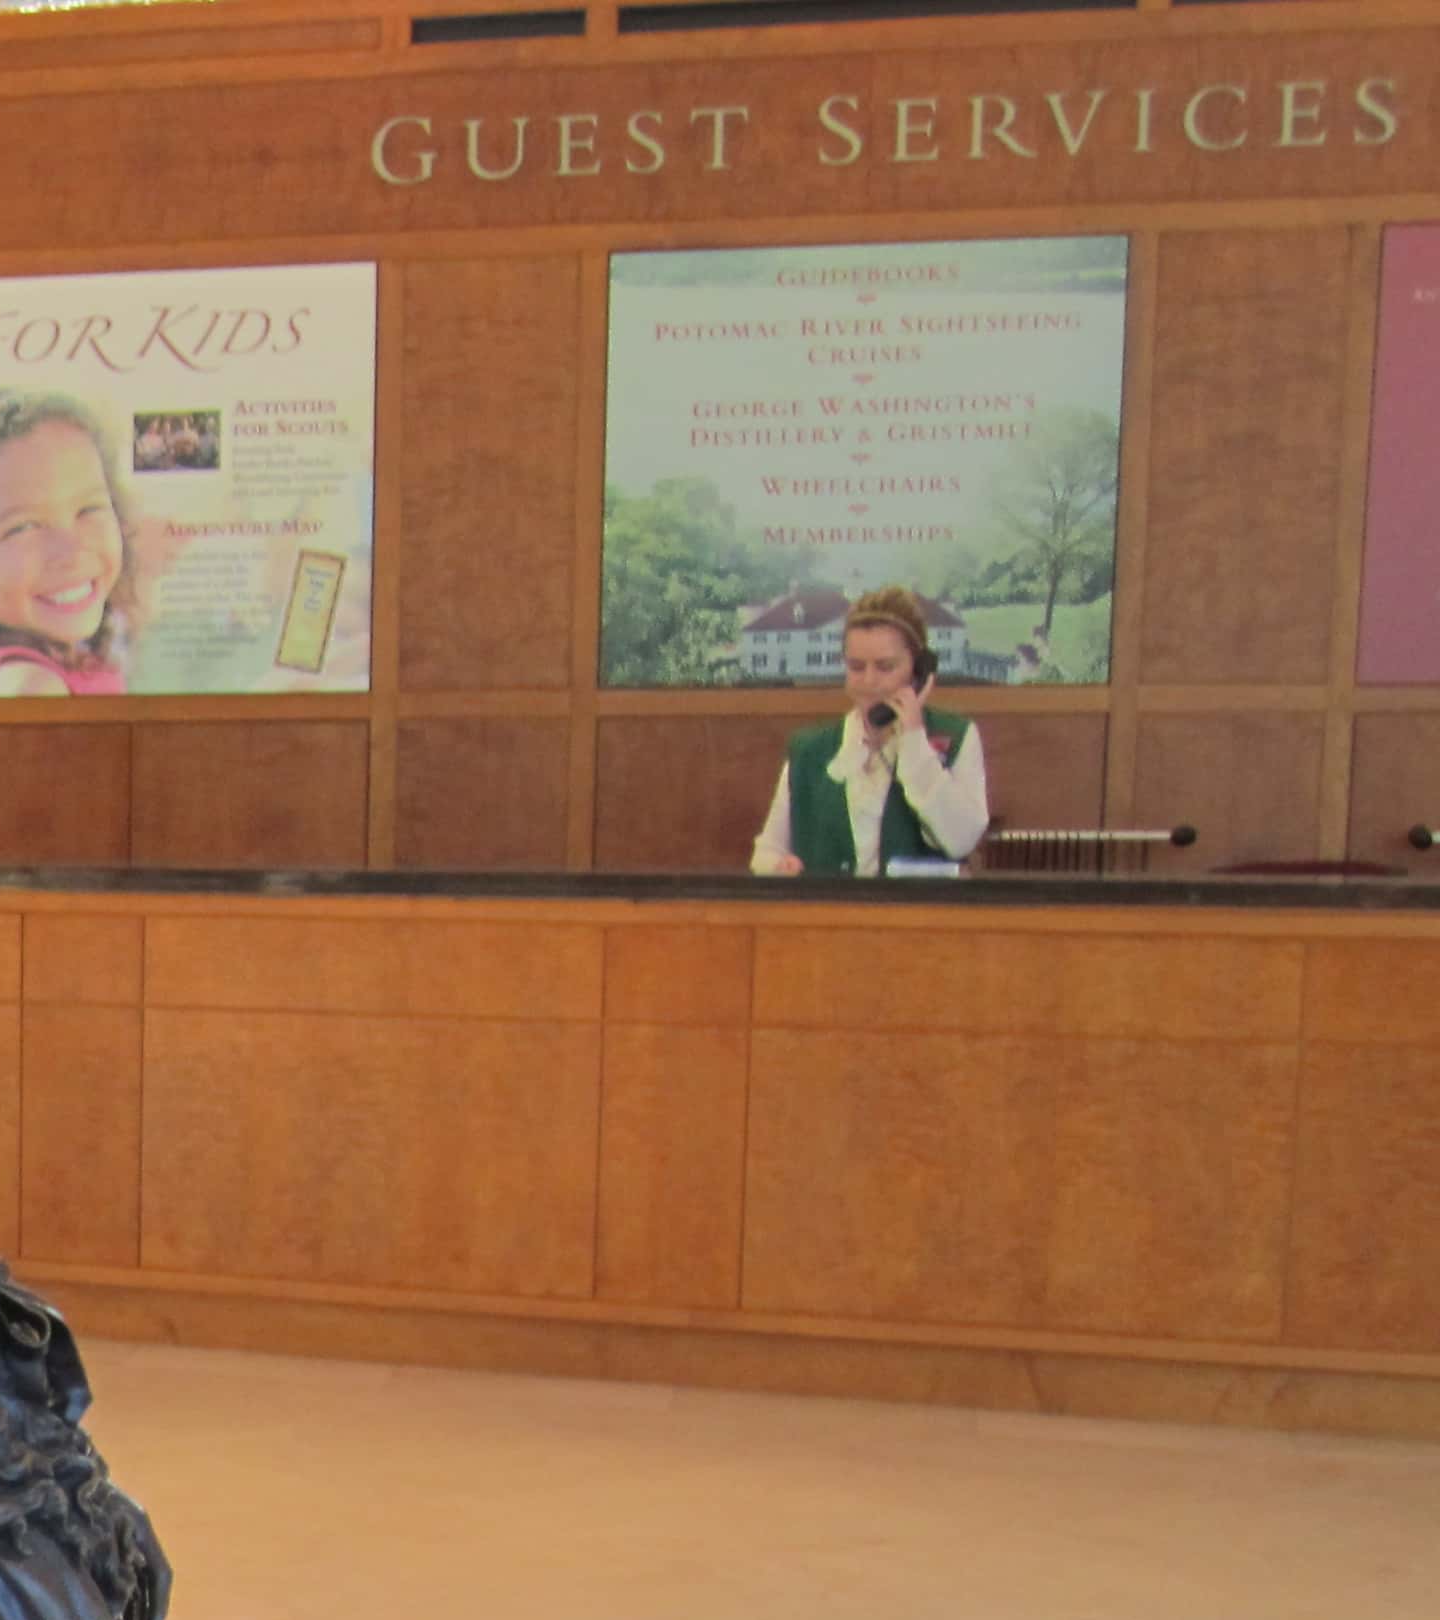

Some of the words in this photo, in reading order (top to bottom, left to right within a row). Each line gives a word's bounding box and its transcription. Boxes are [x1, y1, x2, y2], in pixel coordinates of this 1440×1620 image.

[370, 104, 750, 186] GUEST
[817, 77, 1399, 168] SERVICES
[776, 264, 961, 288] GUIDEBOOKS
[137, 303, 312, 374] KIDS
[653, 321, 786, 342] POTOMAC
[800, 317, 887, 338] RIVER
[899, 311, 1083, 335] SIGHTSEEING
[807, 345, 923, 365] CRUISES
[234, 400, 337, 416] ACTIVITIES
[692, 400, 805, 419] GEORGE
[817, 393, 1037, 417] WASHINGTON'S
[688, 426, 844, 448] DISTILLERY
[886, 422, 1034, 442] GRISTMILL
[760, 473, 962, 497] WHEELCHAIRS
[163, 522, 273, 537] ADVENTURE
[762, 524, 956, 546] MEMBERSHIPS
